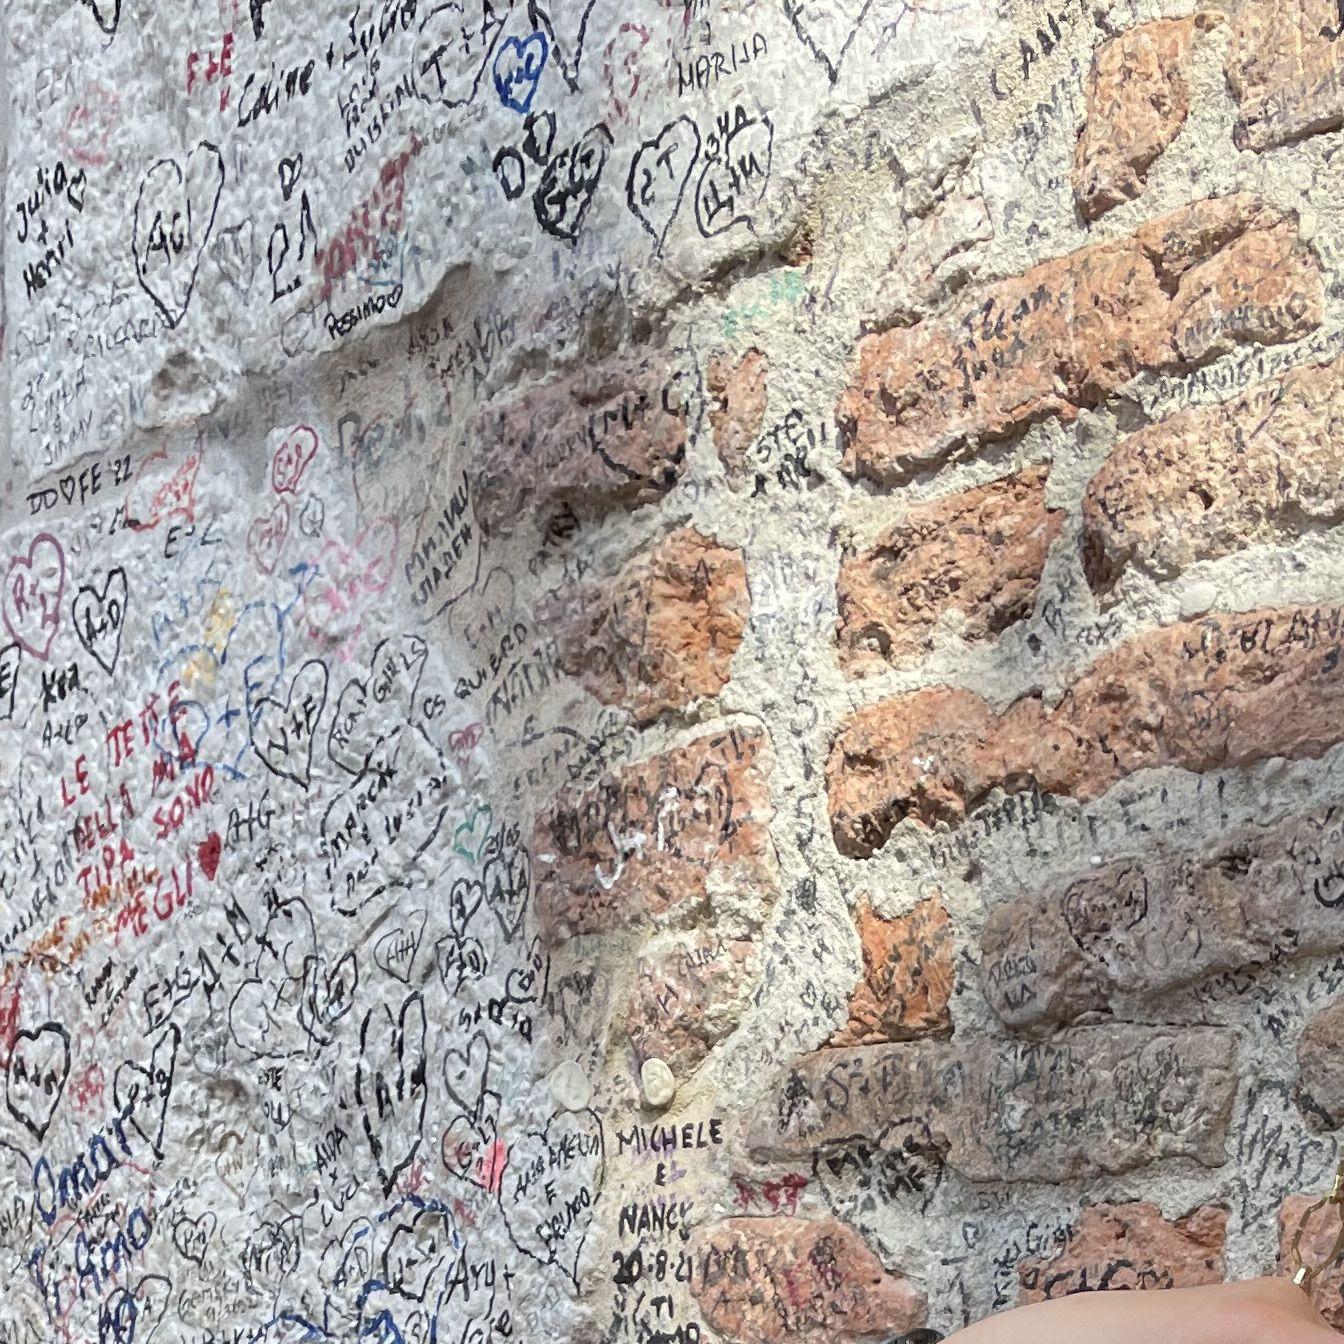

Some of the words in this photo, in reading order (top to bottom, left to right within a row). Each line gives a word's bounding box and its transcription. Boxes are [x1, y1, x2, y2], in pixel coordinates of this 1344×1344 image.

[677, 33, 768, 95] MARIJA
[617, 1118, 723, 1156] MICHELE
[618, 1202, 694, 1242] NANCY
